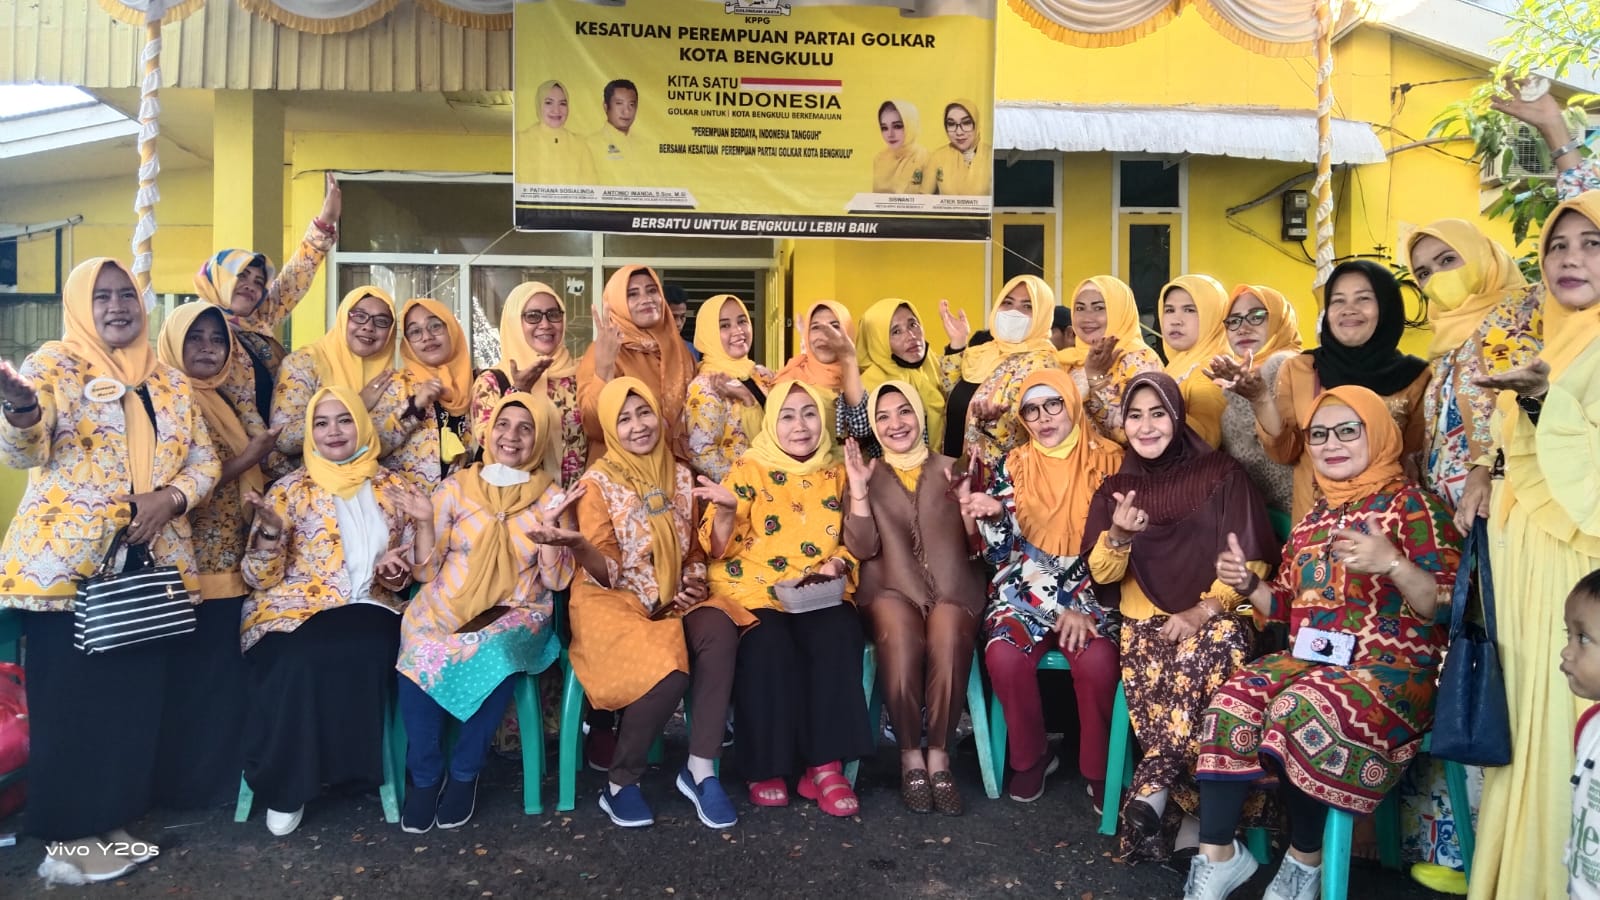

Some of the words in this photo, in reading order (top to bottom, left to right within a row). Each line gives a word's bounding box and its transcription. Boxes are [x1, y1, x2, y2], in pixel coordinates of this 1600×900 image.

[745, 16, 771, 24] KPPG
[575, 21, 671, 39] KESATUAN
[678, 26, 788, 44] PEREMPUAN
[794, 30, 855, 46] PARTAI
[861, 32, 936, 48] GOLKAR
[679, 47, 728, 62] KOTA
[734, 50, 833, 66] BENGKULU
[667, 75, 699, 87] KITA
[702, 76, 739, 89] SATU
[667, 90, 712, 102] UNTUK
[715, 91, 842, 109] INDONESIA
[667, 108, 699, 116] GOLKAR
[700, 109, 726, 117] UNTUK
[731, 110, 750, 118] KOTA
[752, 111, 790, 119] BENGKULU
[791, 111, 842, 121] BERKEMAJUAN
[692, 126, 730, 138] "PEREMPUAN
[730, 128, 758, 140] BERDAYA,
[759, 129, 790, 139] INDONESIA
[791, 130, 822, 140] TANGGUH"
[659, 143, 687, 154] BERSAMA
[688, 144, 719, 155] KESATUAN
[721, 145, 756, 156] PEREMPUAN
[757, 146, 778, 156] PARTAI
[778, 147, 802, 157] GOLKAR
[803, 148, 819, 158] KOTA
[631, 217, 691, 229] BERSATU
[693, 218, 738, 231] UNTUK
[740, 219, 807, 232] BENGKULU
[809, 221, 847, 233] LEBIH
[849, 222, 879, 234] BAIK
